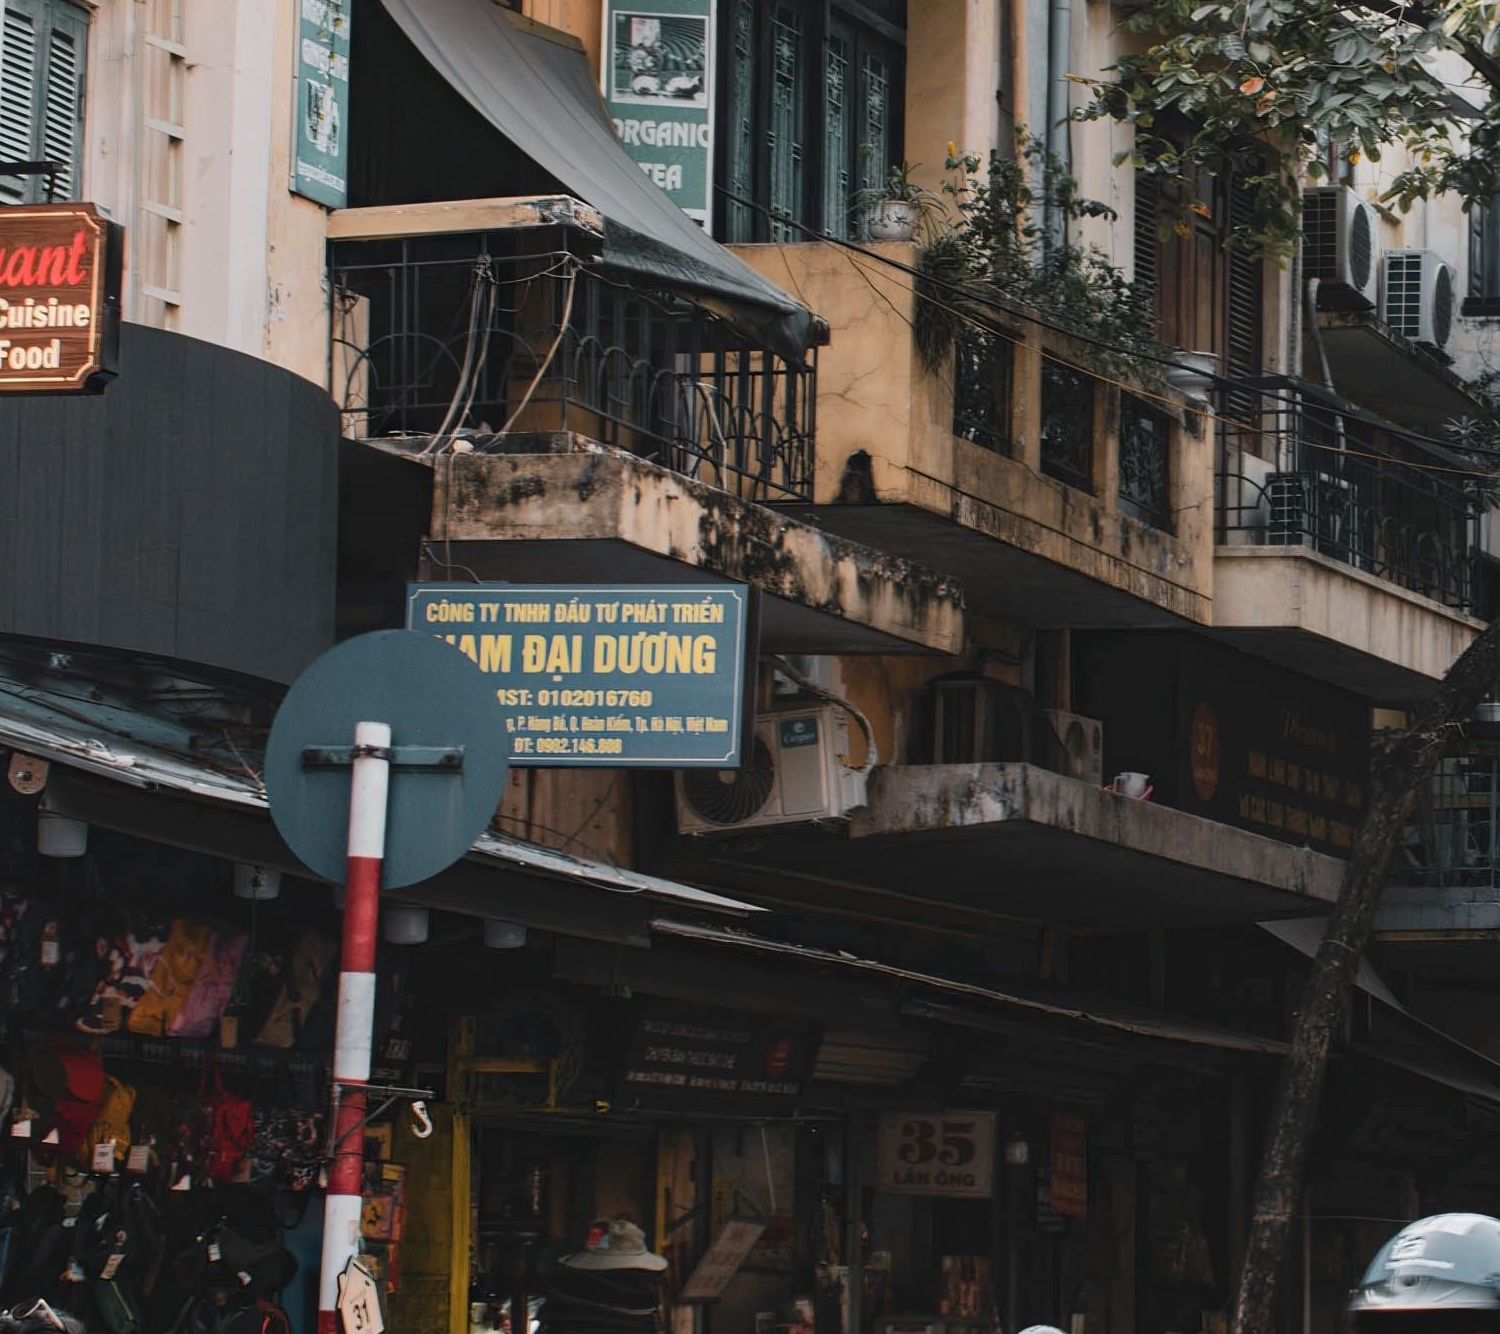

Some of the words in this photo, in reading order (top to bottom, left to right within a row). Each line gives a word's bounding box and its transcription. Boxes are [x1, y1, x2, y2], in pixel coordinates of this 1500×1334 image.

[426, 598, 475, 624] CÔNG
[479, 602, 498, 624] TY
[504, 602, 549, 624] TNHH
[554, 596, 591, 624] ĐẦU
[595, 600, 620, 624] TƯ
[621, 598, 668, 624] PHÁT
[671, 595, 725, 624] TRIỂN
[522, 633, 583, 682] ĐẠI
[593, 630, 717, 675] DƯƠNG
[899, 1120, 978, 1166] 35
